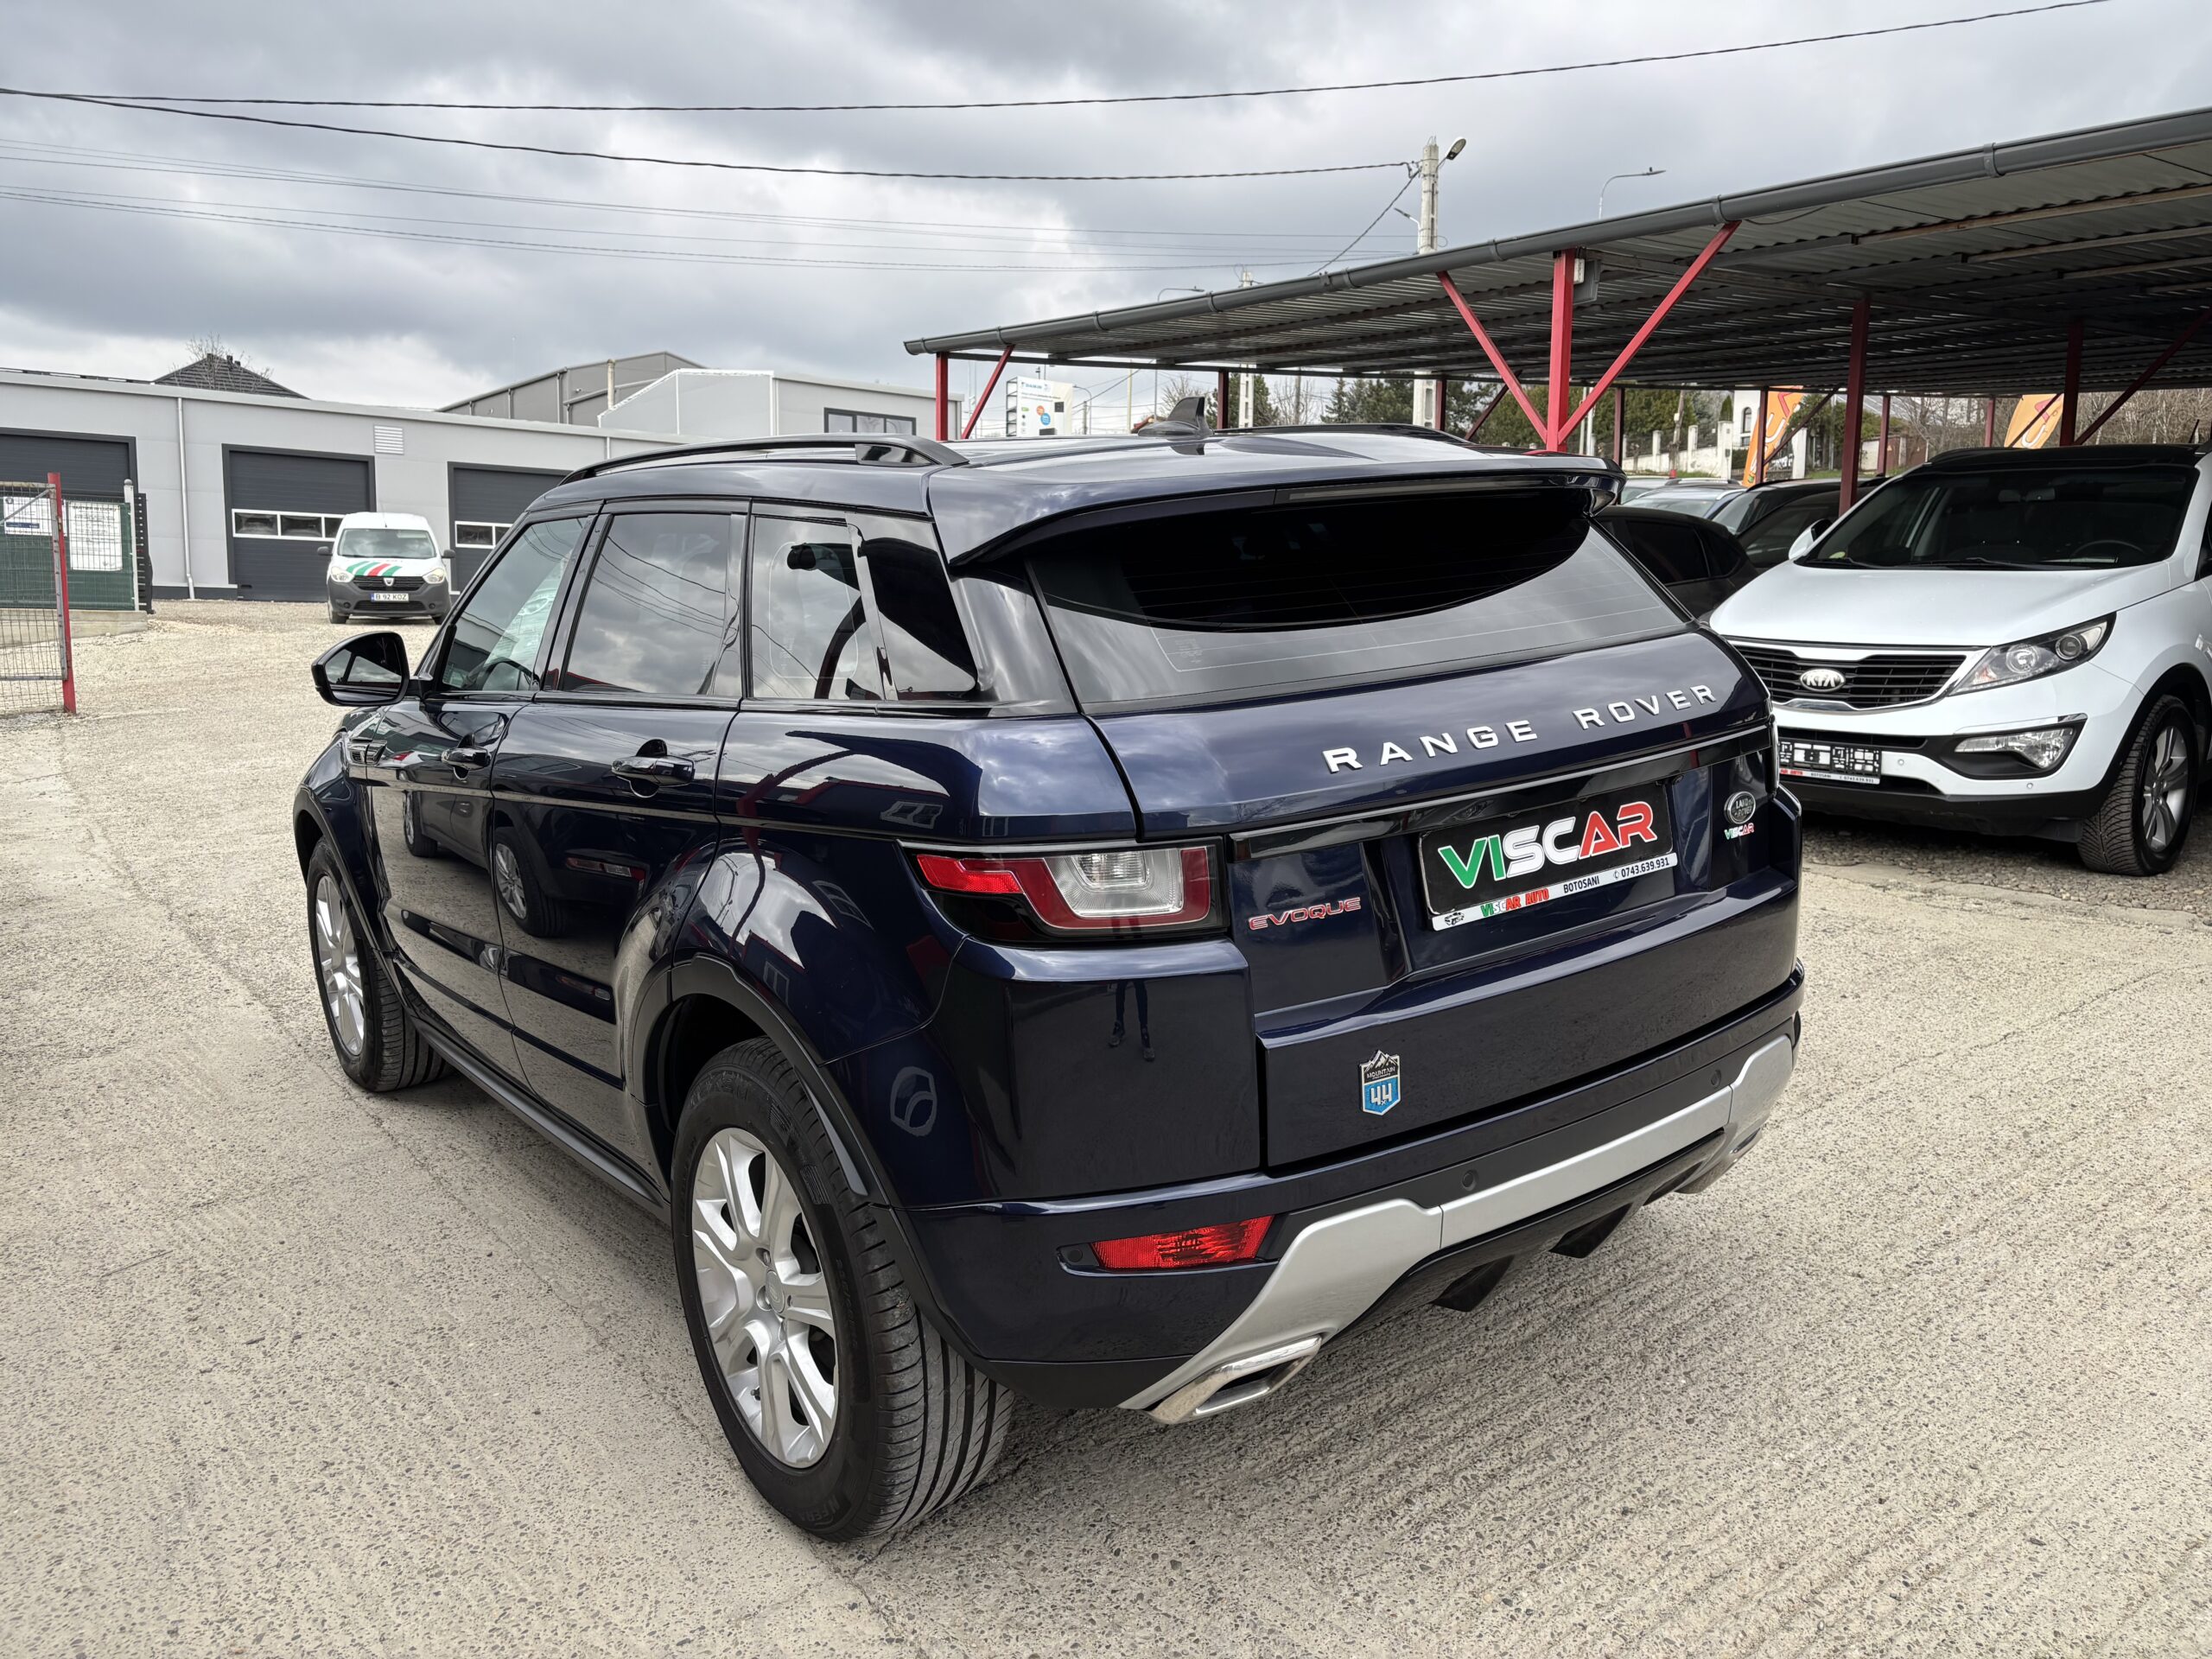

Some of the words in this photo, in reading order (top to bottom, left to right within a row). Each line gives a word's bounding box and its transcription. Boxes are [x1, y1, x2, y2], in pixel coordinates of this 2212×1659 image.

[1806, 673, 1835, 688] KIA
[1322, 720, 1538, 774] RANGE
[1572, 684, 1717, 730] ROVER
[1437, 801, 1658, 889] VISCAR
[1724, 823, 1755, 840] VISCAR
[1480, 895, 1522, 918] VISCAR
[1525, 887, 1549, 906] AUTO
[1563, 876, 1600, 893] BOTOSANI
[1621, 857, 1670, 878] 0743.639.931
[1248, 897, 1362, 931] EVOQUE
[1366, 1066, 1395, 1079] MOUNTAIN
